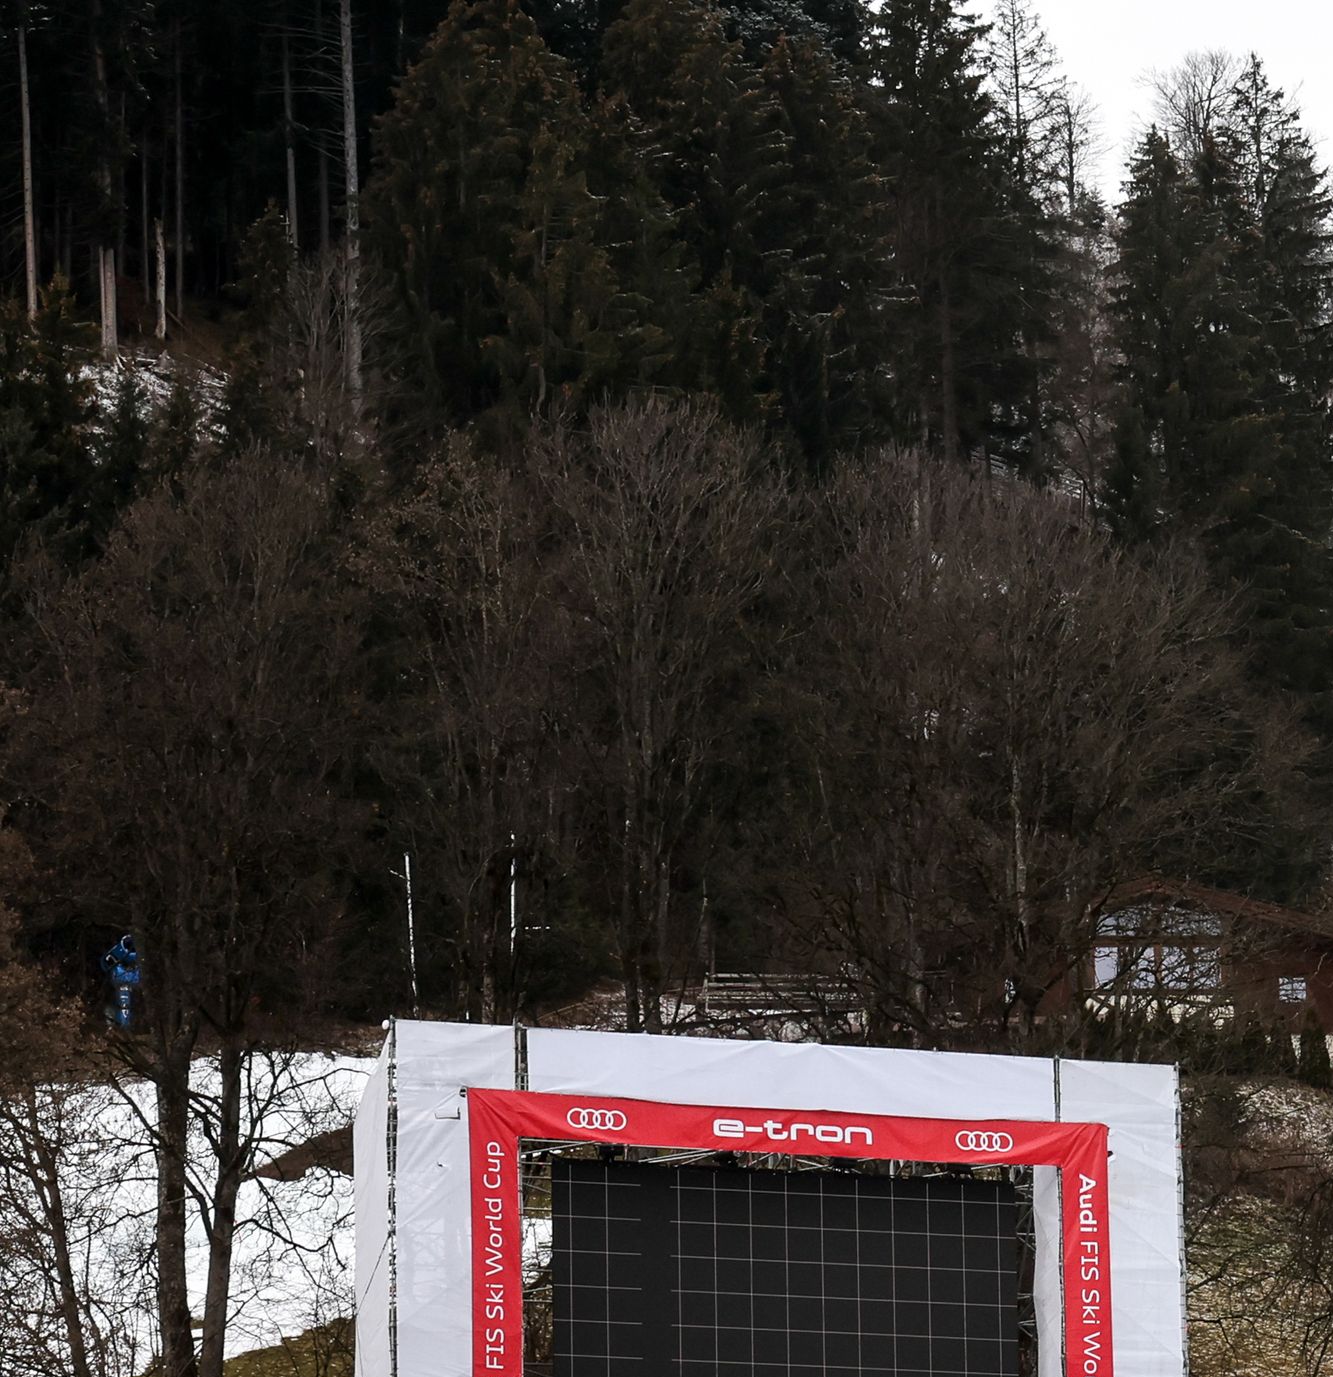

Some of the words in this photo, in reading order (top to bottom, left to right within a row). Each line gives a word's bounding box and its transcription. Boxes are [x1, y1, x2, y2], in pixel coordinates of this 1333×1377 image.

[712, 1118, 874, 1146] e-tron
[483, 1141, 505, 1189] Cup
[1078, 1173, 1098, 1233] Audi
[484, 1197, 504, 1277] World
[1080, 1241, 1100, 1281] FIS
[485, 1283, 505, 1321] Ski
[1081, 1289, 1101, 1325] Ski
[485, 1328, 505, 1370] FIS
